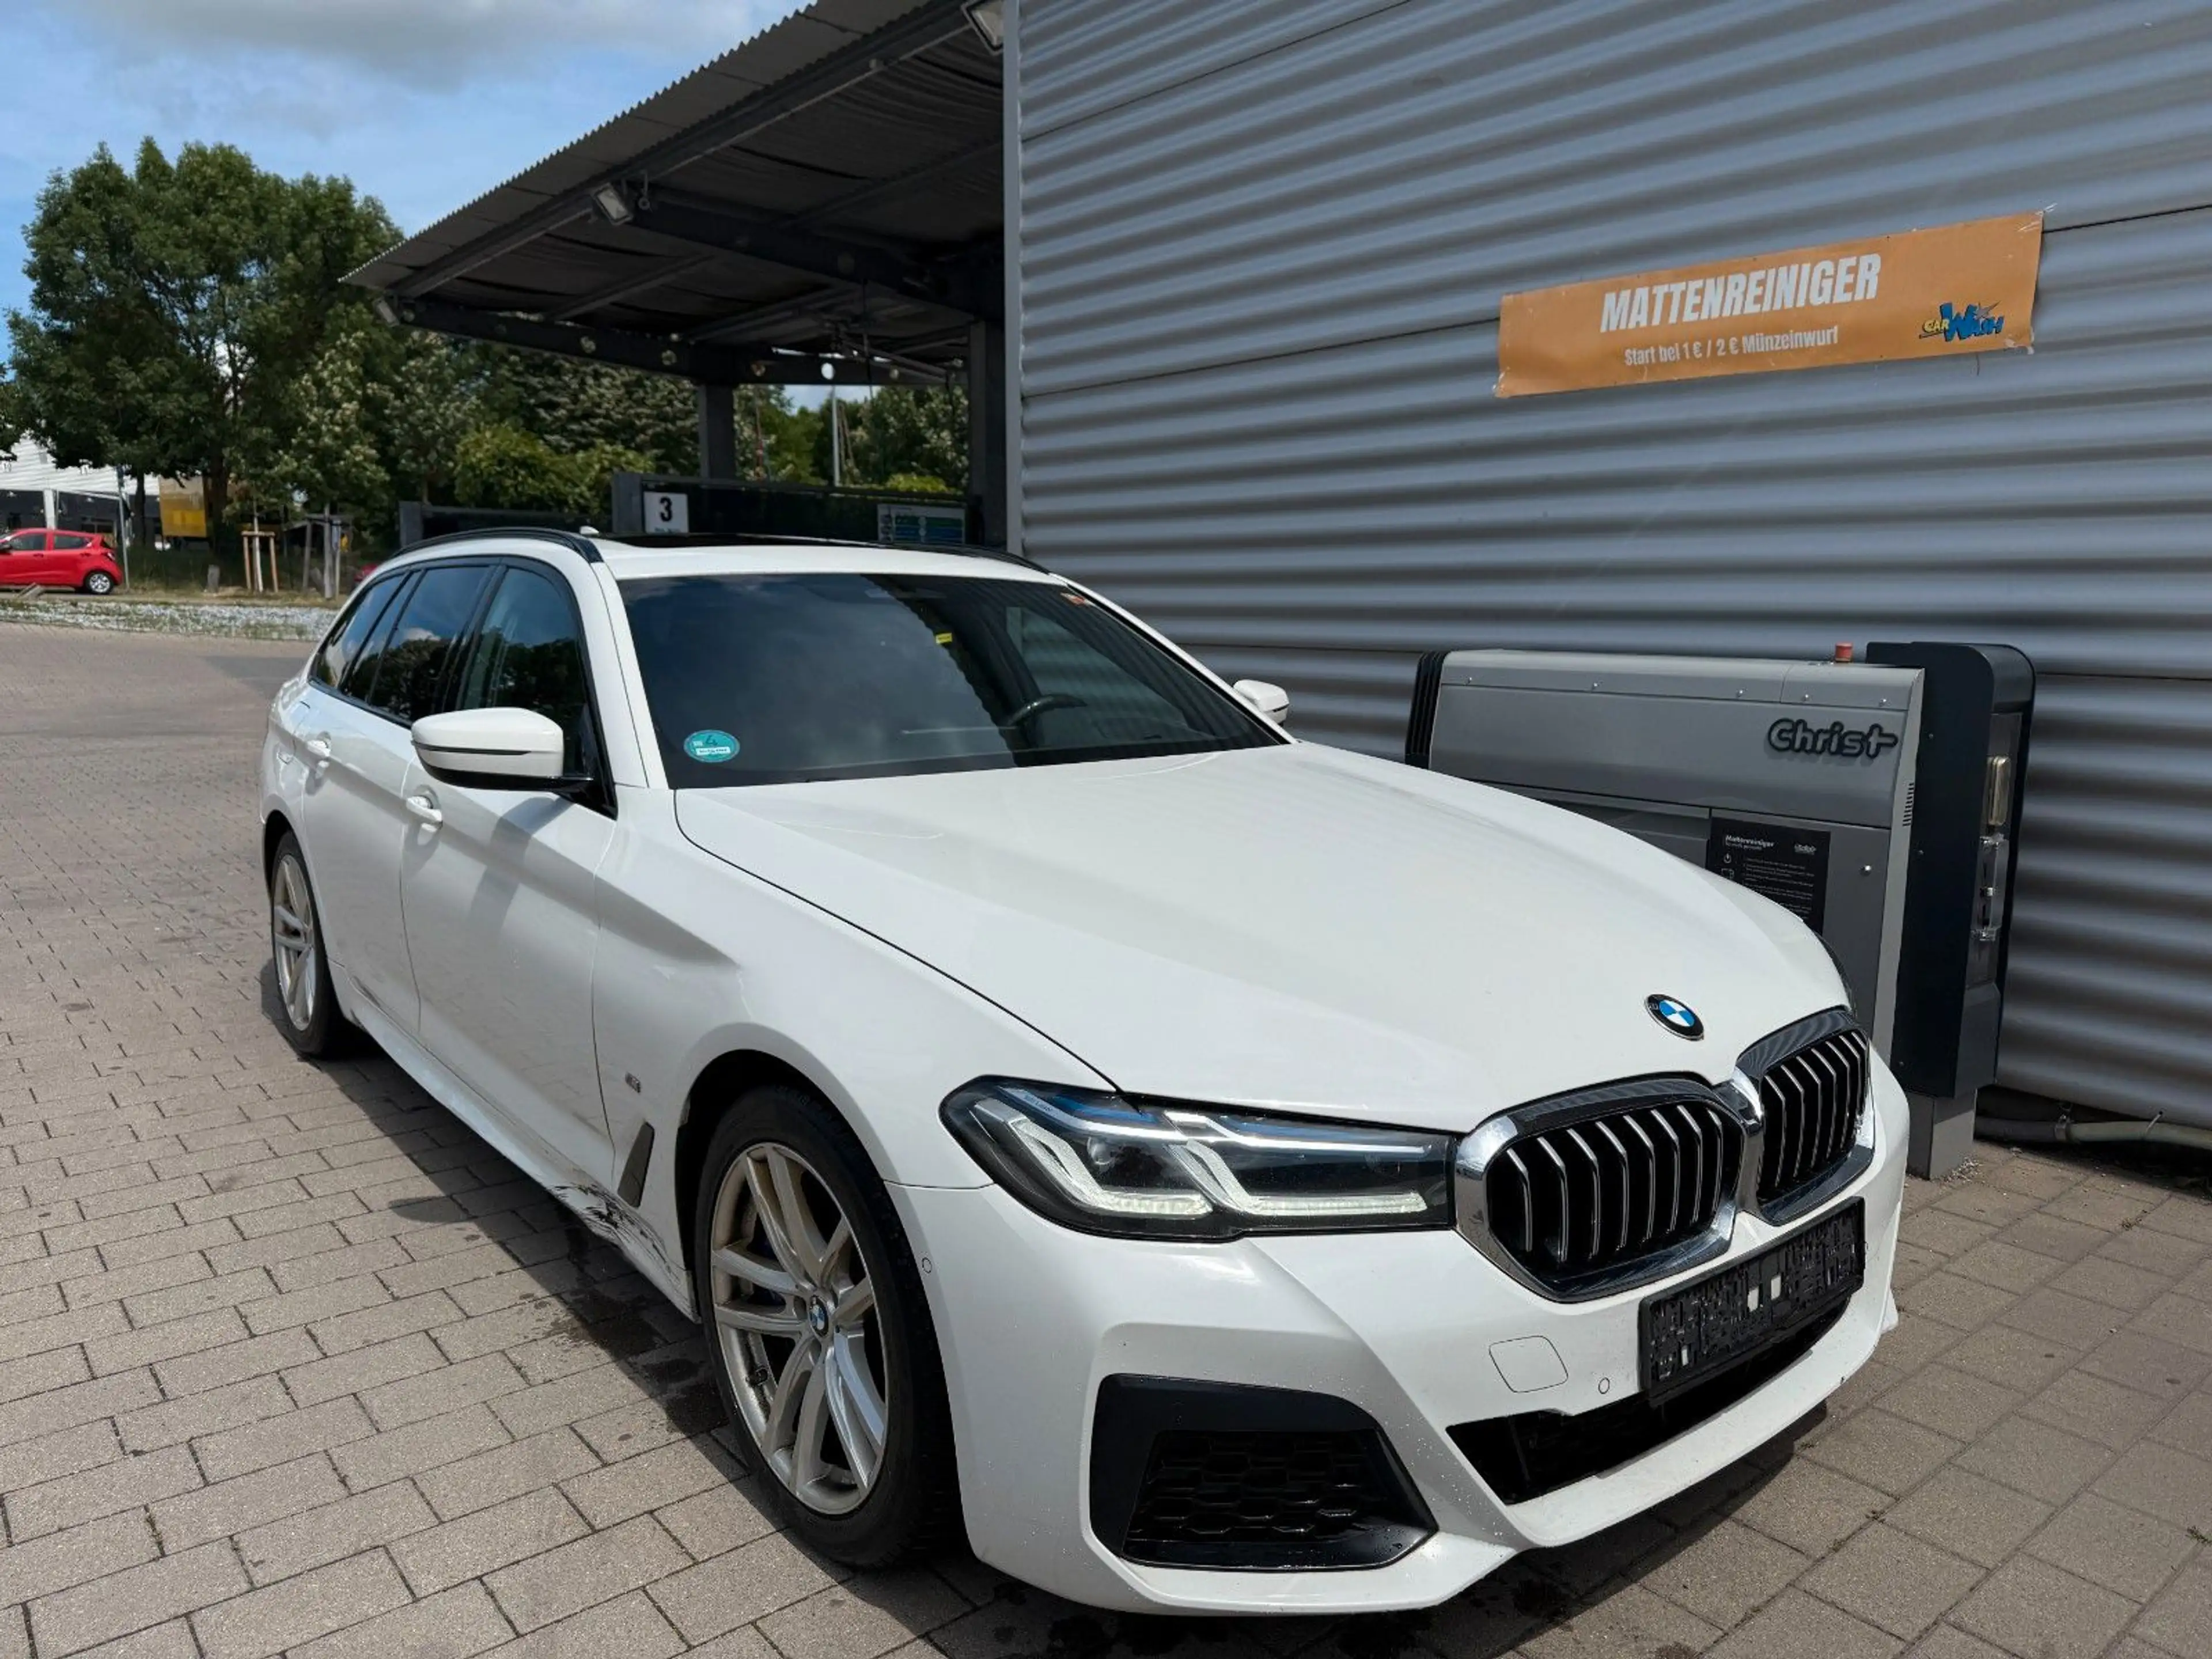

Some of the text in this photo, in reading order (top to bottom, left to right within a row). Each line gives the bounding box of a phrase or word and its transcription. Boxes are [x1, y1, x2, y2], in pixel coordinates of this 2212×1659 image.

[1600, 253, 1882, 333] MATTENREINIGER
[1624, 346, 1656, 366] Start
[1682, 342, 1690, 359] 1
[1693, 341, 1703, 358] €
[1706, 339, 1712, 359] /
[1716, 338, 1726, 356] 2
[1729, 336, 1739, 355] €
[1742, 325, 1839, 354] Münzeinwurf
[1923, 319, 1949, 333] CAR
[660, 497, 673, 522] 3
[1767, 717, 1899, 759] Christ
